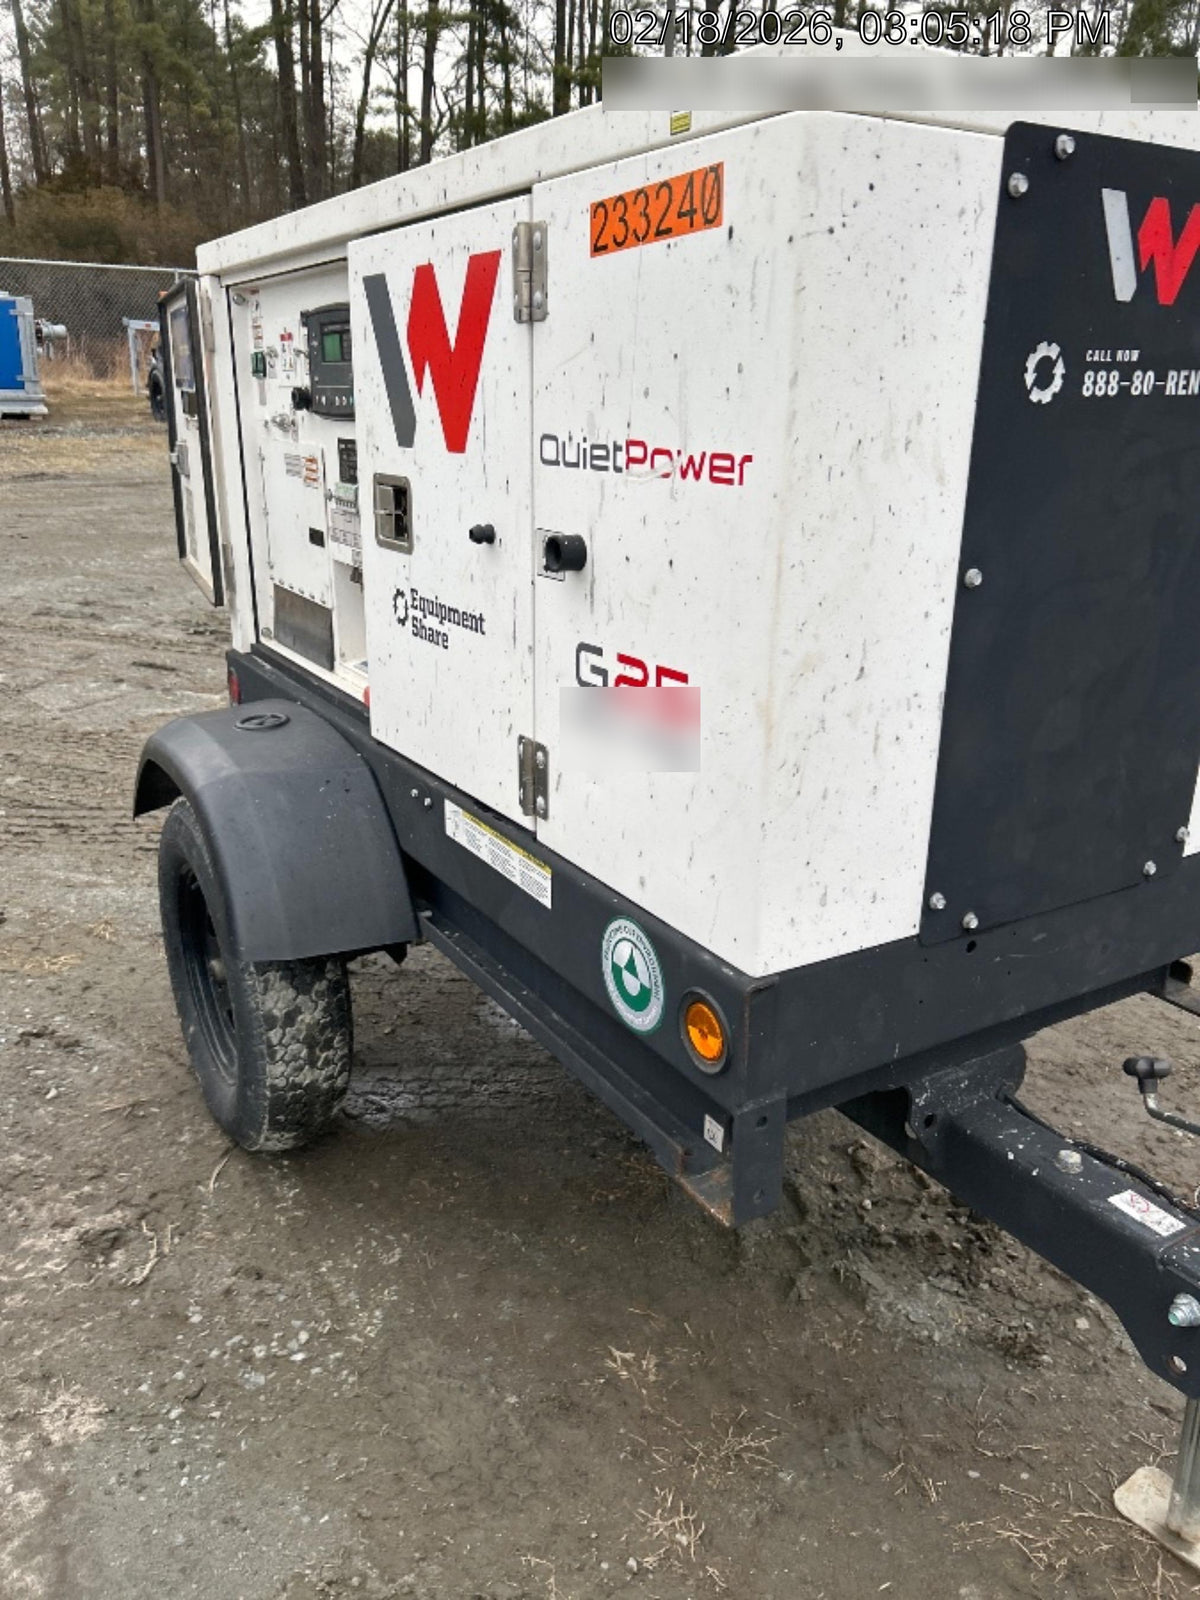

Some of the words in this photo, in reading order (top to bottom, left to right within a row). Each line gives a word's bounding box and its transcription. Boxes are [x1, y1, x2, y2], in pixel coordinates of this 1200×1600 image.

[592, 165, 722, 253] 233240
[1085, 349, 1112, 362] CALL
[1116, 349, 1141, 362] NOW
[410, 587, 486, 636] Equipment
[411, 614, 449, 650] Share
